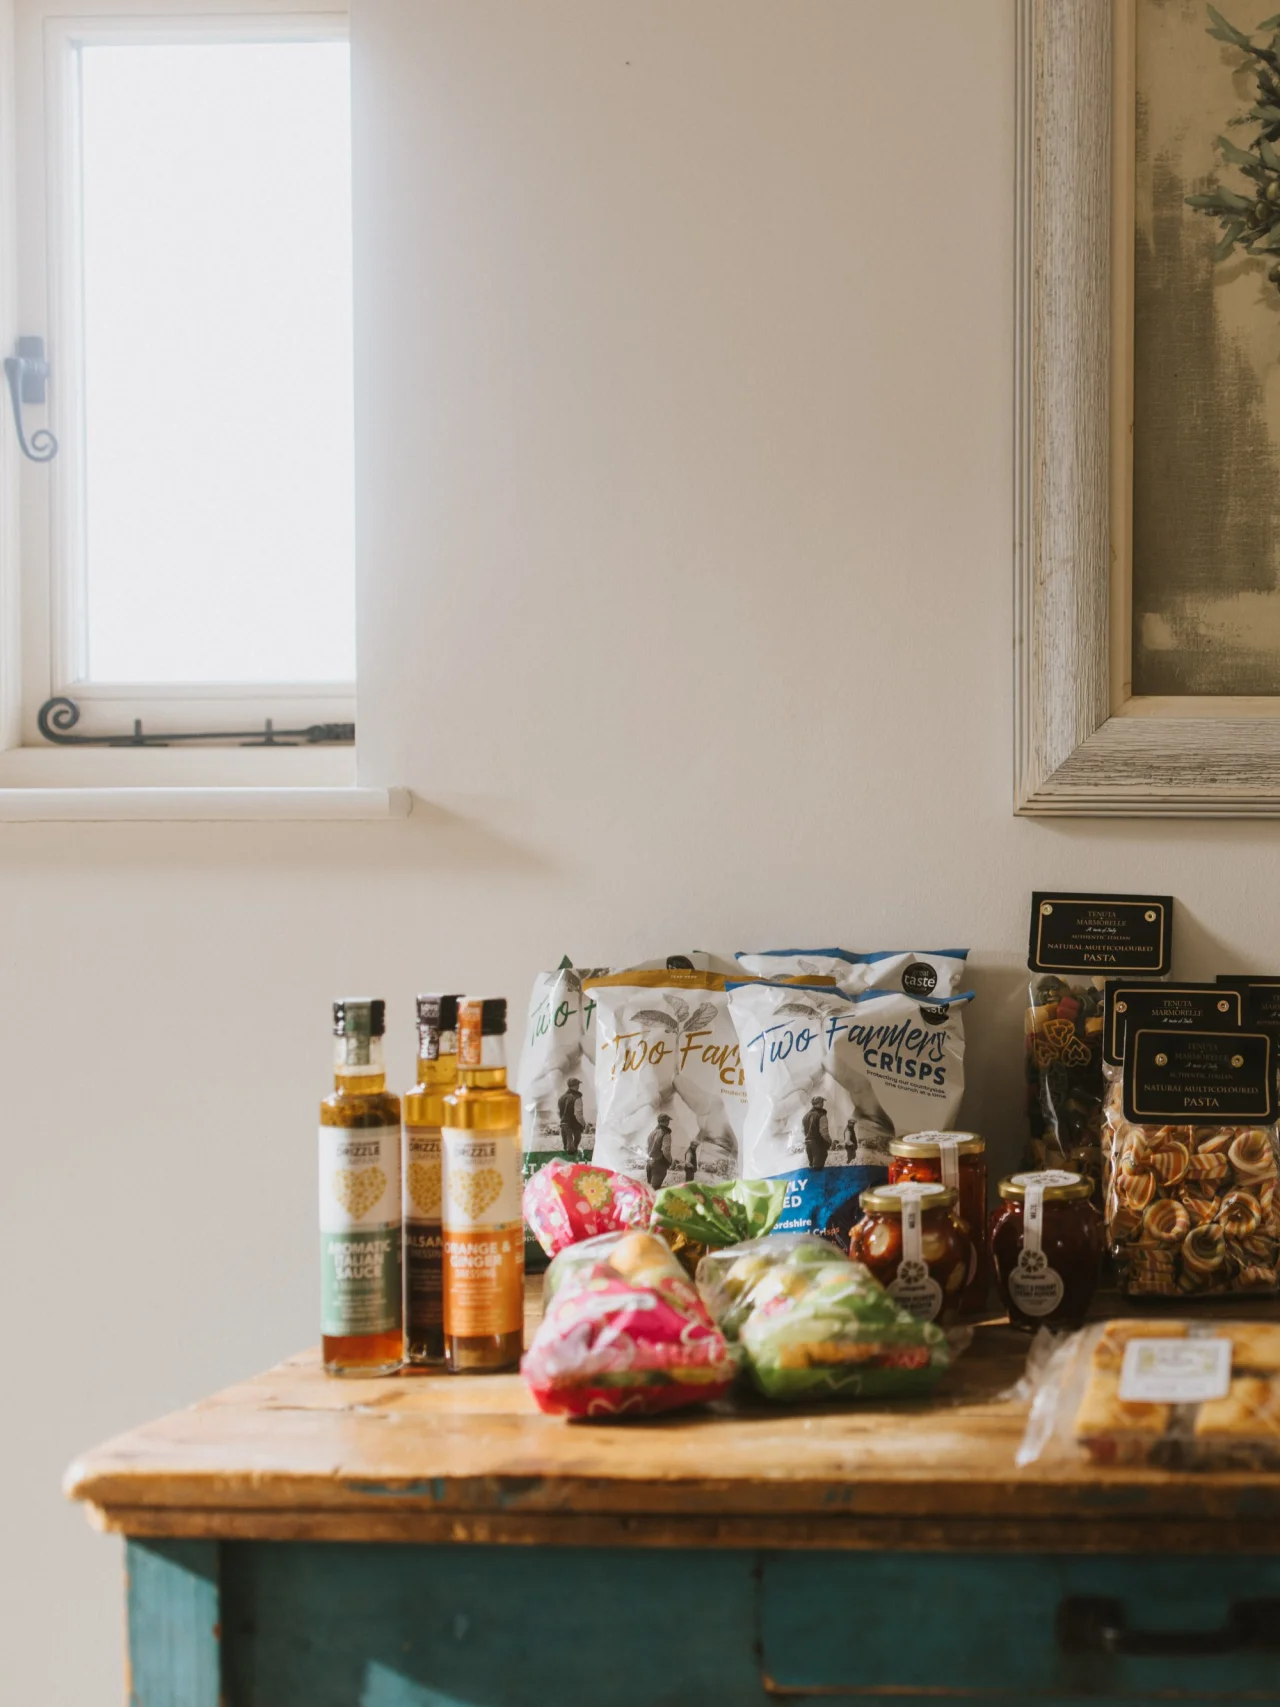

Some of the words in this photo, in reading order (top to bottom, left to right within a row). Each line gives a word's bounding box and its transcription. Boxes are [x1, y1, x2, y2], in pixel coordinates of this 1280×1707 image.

[1087, 910, 1116, 918] TENUTA
[1085, 944, 1153, 952] MULTICOLOURED
[1083, 953, 1117, 962] PASTA
[904, 975, 935, 988] taste
[1163, 999, 1193, 1008] TENUTA
[1151, 1009, 1203, 1017] MARMORELLE
[530, 995, 578, 1047] Two
[747, 1019, 819, 1073] Two
[825, 1014, 947, 1063] Farmers
[601, 1030, 673, 1081] Two
[863, 1049, 947, 1086] CRISPS
[866, 1069, 898, 1084] Protecting
[910, 1082, 945, 1094] countryside
[720, 1088, 748, 1098] Protecti
[898, 1085, 919, 1094] crunch
[1144, 1084, 1182, 1092] NATURAL
[1184, 1085, 1259, 1094] MULTICOLOURED
[1183, 1097, 1220, 1107] PASTA
[782, 1196, 802, 1209] ED
[773, 1218, 812, 1230] ordshire
[326, 1239, 392, 1254] AROMATIC
[445, 1242, 498, 1254] ORANGE
[502, 1240, 511, 1252] &
[334, 1253, 385, 1267] ITALIAN
[449, 1255, 503, 1267] GINGER
[335, 1265, 383, 1280] SAUCE
